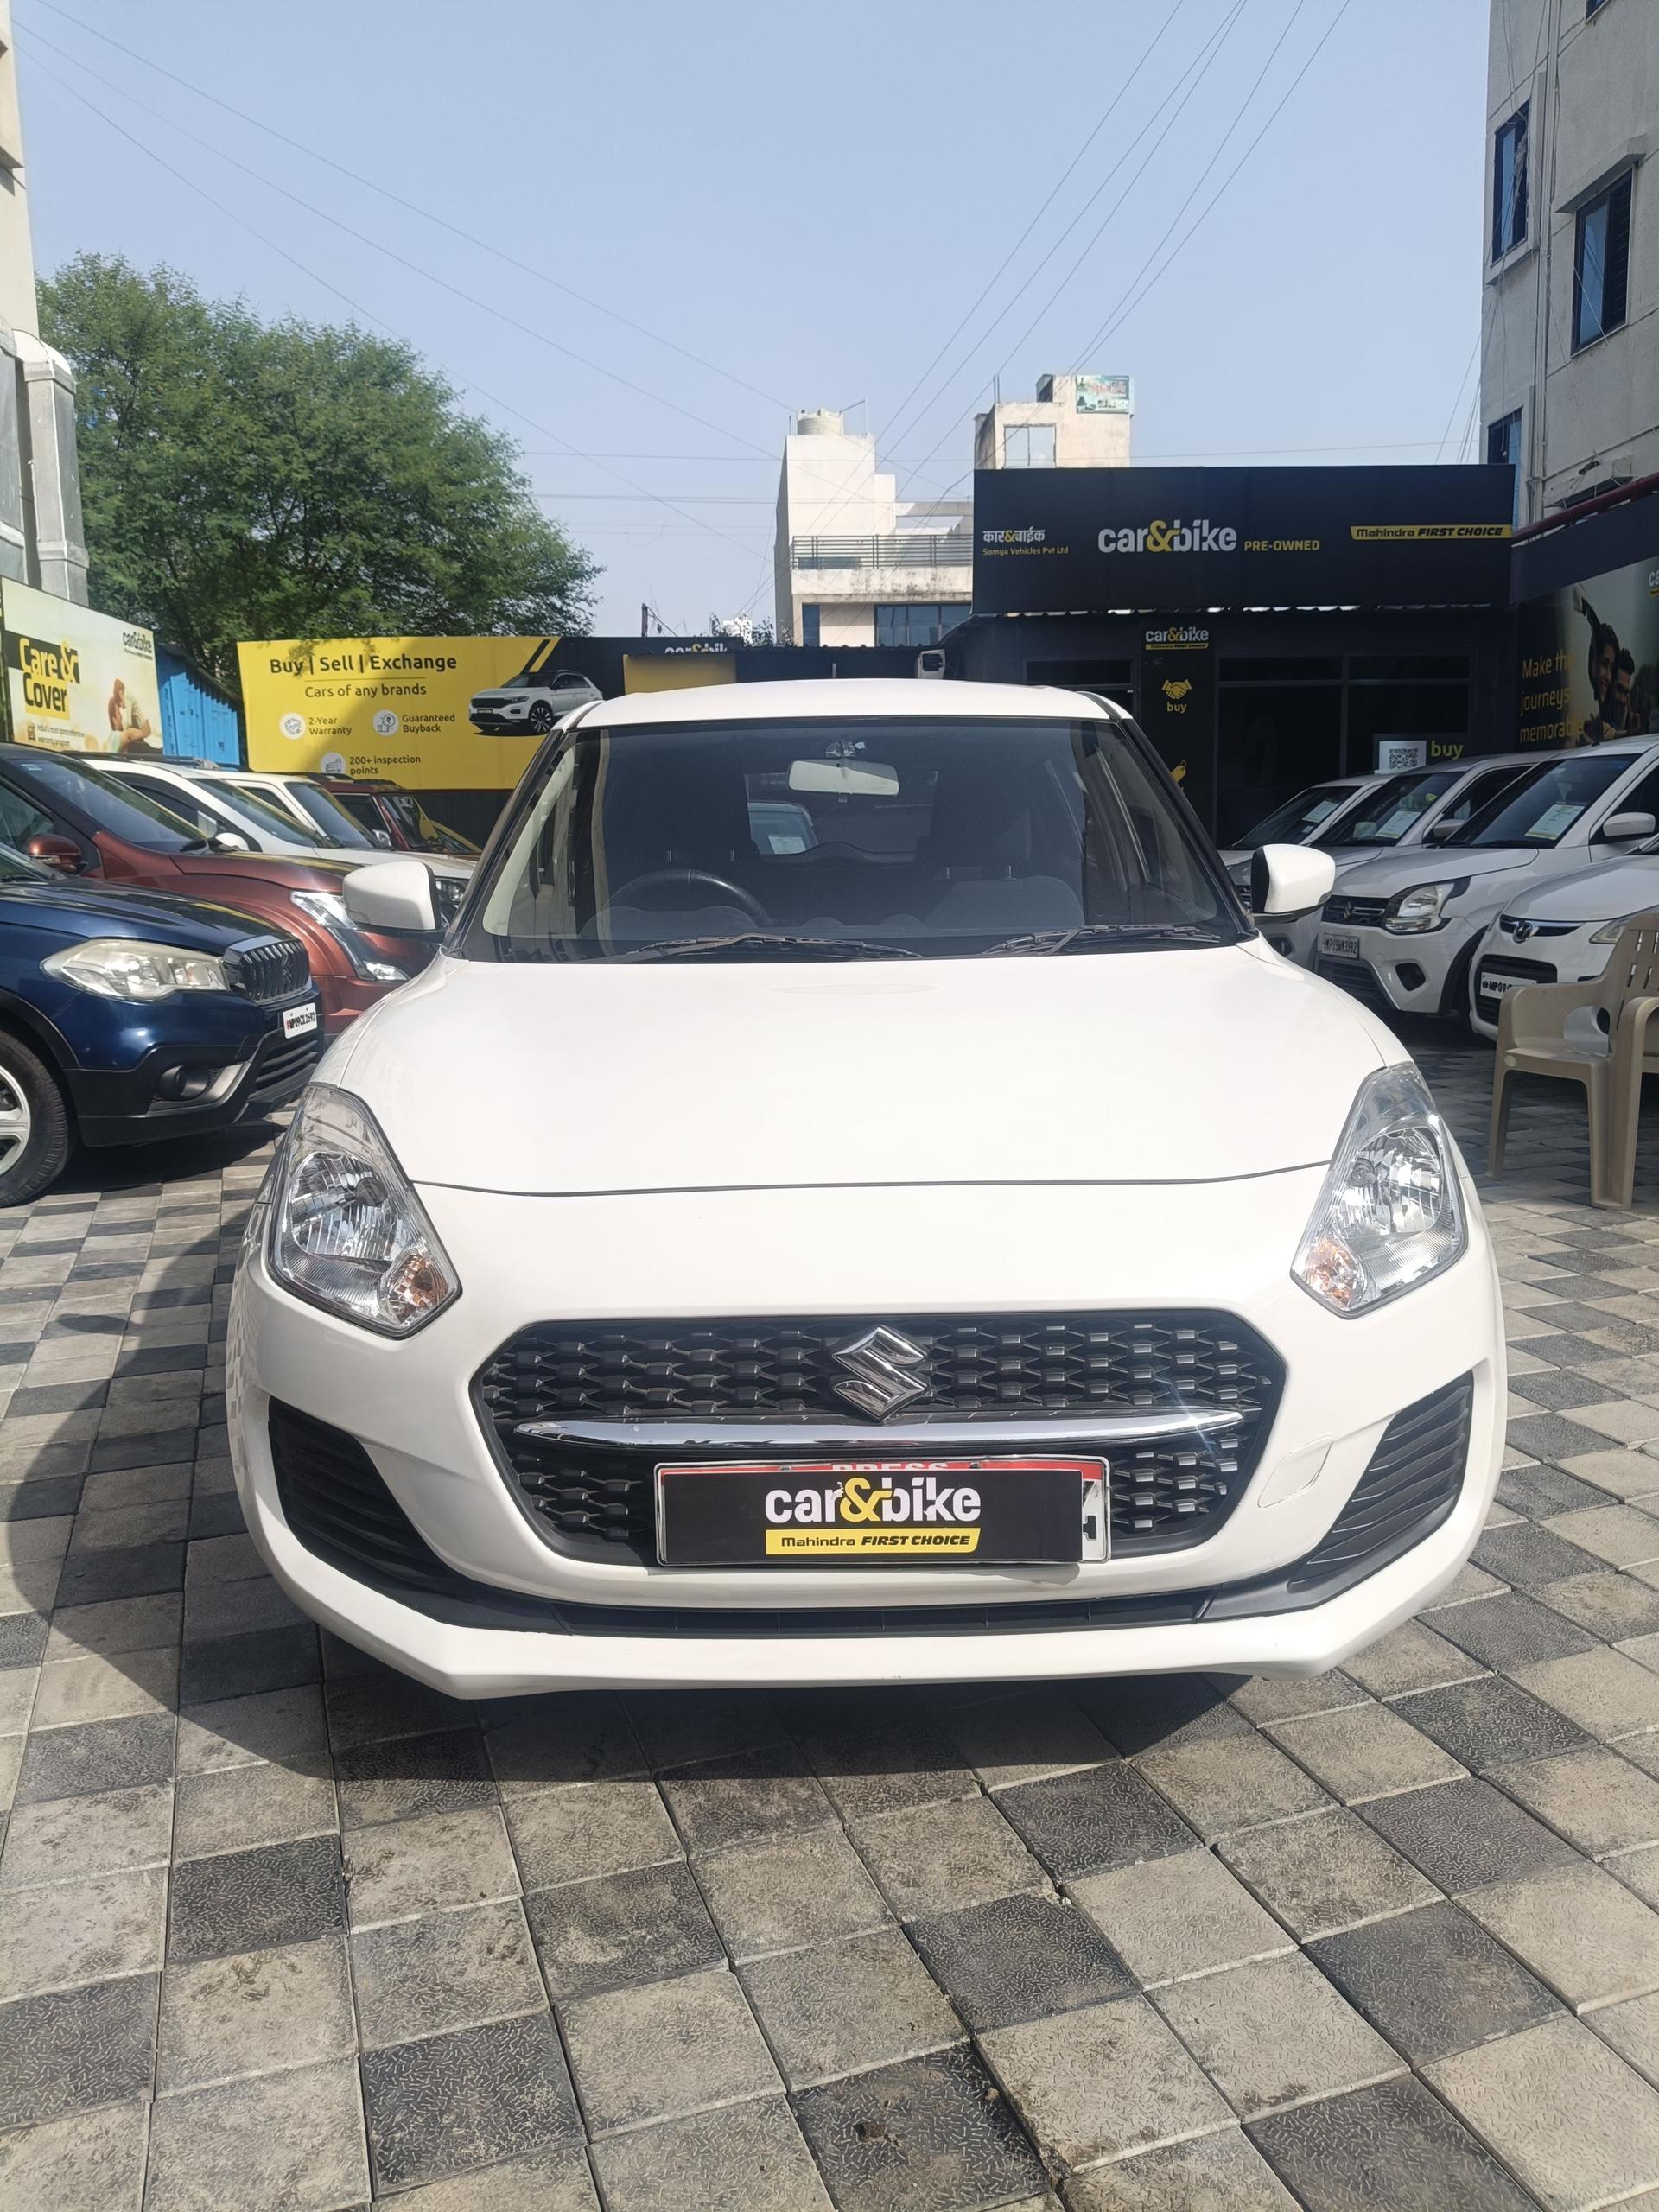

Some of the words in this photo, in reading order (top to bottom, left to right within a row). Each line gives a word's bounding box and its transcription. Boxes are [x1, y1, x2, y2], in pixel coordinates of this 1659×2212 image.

[1097, 519, 1237, 553] car&bike
[1357, 527, 1414, 537] Mahindra
[1418, 526, 1454, 537] FIRST
[1457, 525, 1503, 537] CHOICE
[982, 548, 1008, 556] Somya
[1010, 546, 1040, 555] Vehicles
[1057, 545, 1069, 554] Ltd
[1244, 540, 1319, 551] PRE-OWNED
[1145, 626, 1209, 642] car&bike
[20, 639, 57, 677] Care
[270, 658, 303, 677] Buy
[320, 656, 353, 671] Sell
[371, 654, 457, 671] Exchange
[1522, 654, 1552, 678] Make
[23, 672, 67, 712] Cover
[305, 686, 334, 698] Cars
[337, 684, 351, 697] of
[355, 686, 378, 699] any
[382, 683, 427, 696] brands
[1166, 702, 1187, 714] buy
[309, 716, 337, 727] 2-Year
[403, 714, 455, 724] Guaranteed
[309, 728, 352, 737] Warranty
[403, 724, 442, 734] Buyback
[1431, 741, 1463, 760] buy
[349, 755, 372, 766] 200+
[373, 754, 421, 766] inspection
[350, 766, 379, 776] points
[765, 1476, 982, 1523] car&bike
[781, 1536, 855, 1547] Mahindra
[861, 1535, 908, 1547] FIRST
[912, 1535, 970, 1546] CHOICE
